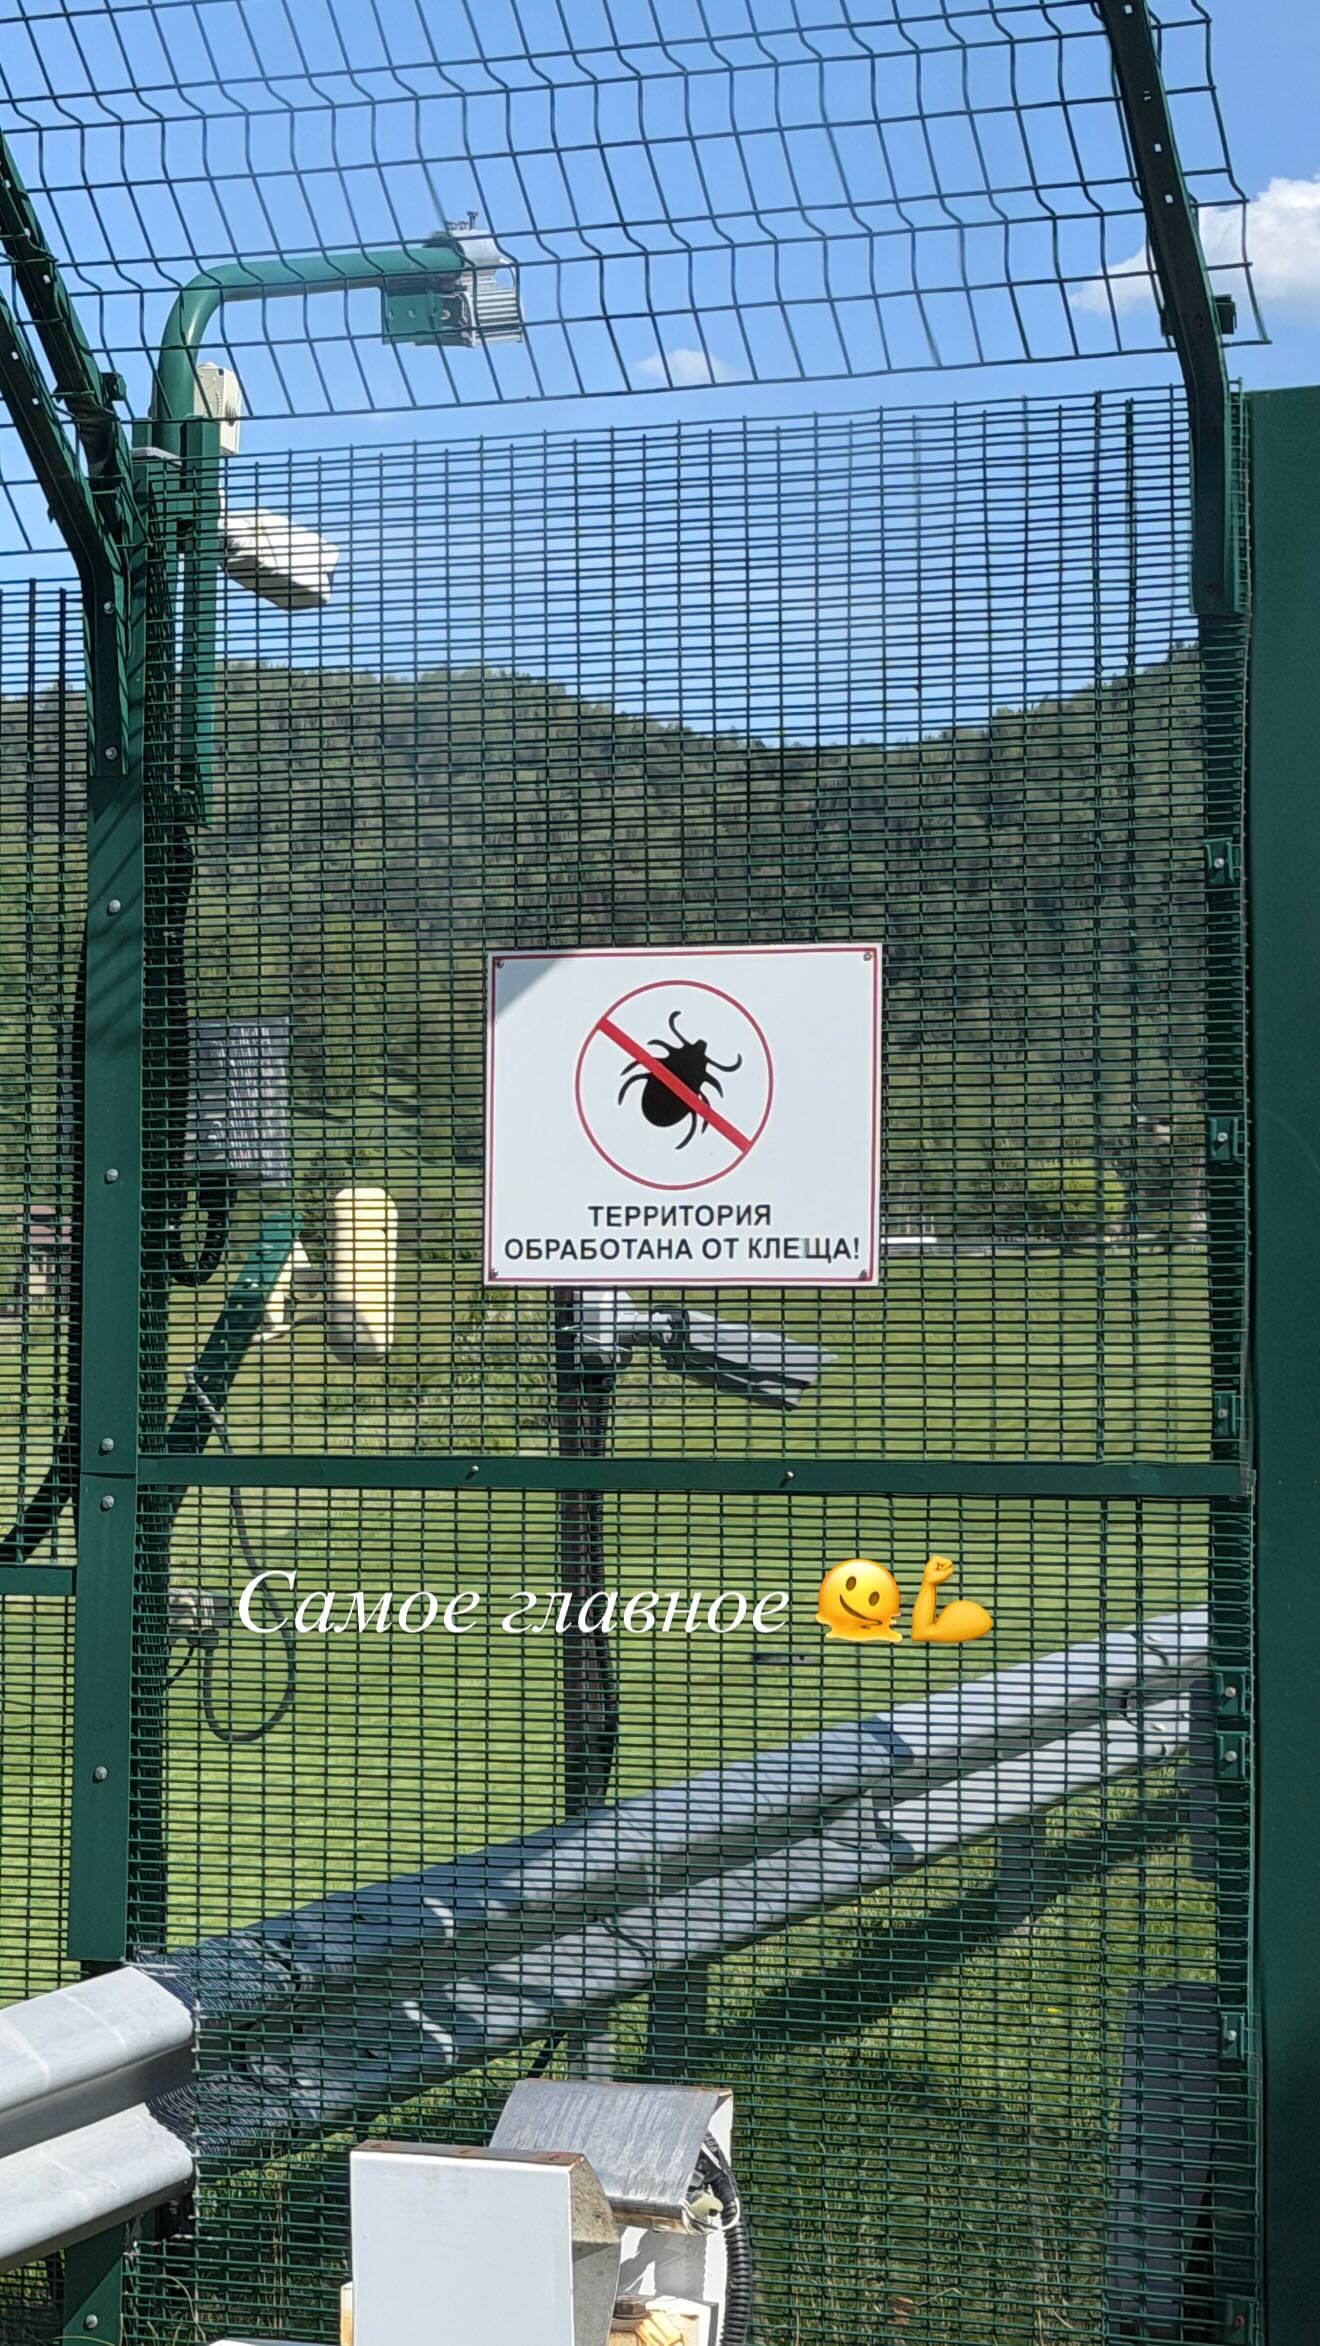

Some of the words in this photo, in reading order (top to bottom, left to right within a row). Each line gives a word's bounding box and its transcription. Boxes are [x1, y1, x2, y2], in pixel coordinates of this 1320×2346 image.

[587, 1204, 771, 1227] ТЕРРИТОРИЯ
[504, 1238, 693, 1260] ОБРАБОТАНА
[702, 1238, 740, 1260] ОТ
[748, 1237, 860, 1263] КЛЕЩА!
